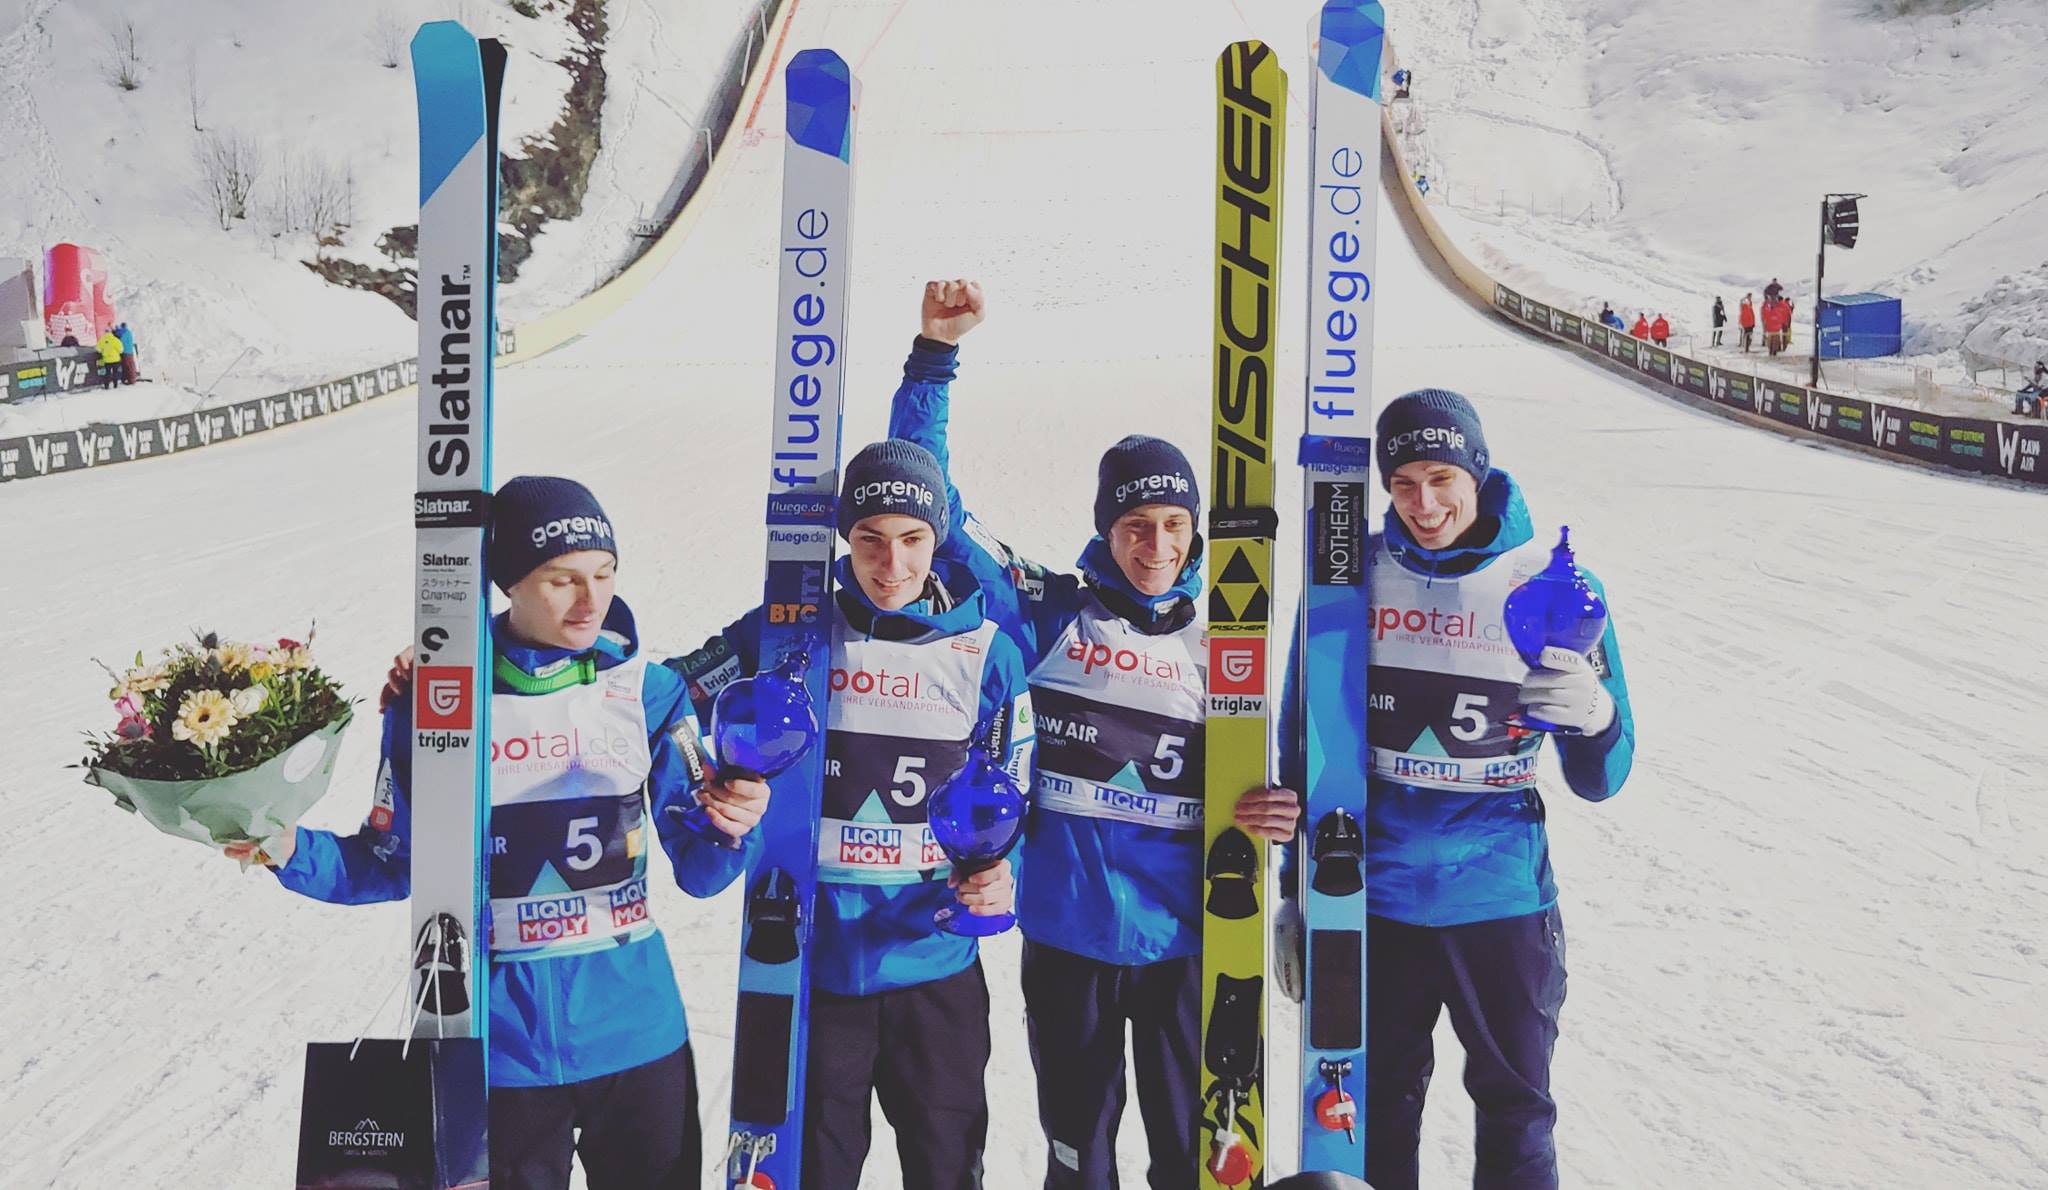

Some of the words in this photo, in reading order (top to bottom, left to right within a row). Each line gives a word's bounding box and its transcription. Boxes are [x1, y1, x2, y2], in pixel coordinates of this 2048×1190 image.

[1216, 40, 1271, 511] FISCHER
[1313, 147, 1371, 419] fluege.de
[773, 208, 836, 488] fluege.de
[428, 274, 471, 477] Slatnar
[1387, 426, 1465, 456] gorenje
[2021, 438, 2040, 456] RAW
[2020, 456, 2036, 472] AIR
[854, 480, 933, 506] gorenje
[1115, 472, 1189, 503] gorenje
[532, 515, 612, 548] gorenje
[1330, 483, 1349, 585] INOTHERM
[769, 603, 818, 624] BTC
[1211, 696, 1262, 715] triglav
[1369, 694, 1395, 711] AIR
[1450, 693, 1488, 741] 5
[418, 732, 470, 753] triglav
[1065, 721, 1098, 744] AIR
[825, 760, 841, 777] IR
[1150, 733, 1186, 780] 5
[890, 756, 926, 807] 5
[489, 836, 508, 855] IR
[565, 816, 603, 871] 5
[843, 827, 900, 847] LIQUI
[842, 845, 900, 863] MOLY
[520, 896, 585, 920] LIQUI
[614, 902, 647, 926] MO
[521, 917, 588, 940] MOLY
[328, 1130, 404, 1148] BERGSTERN
